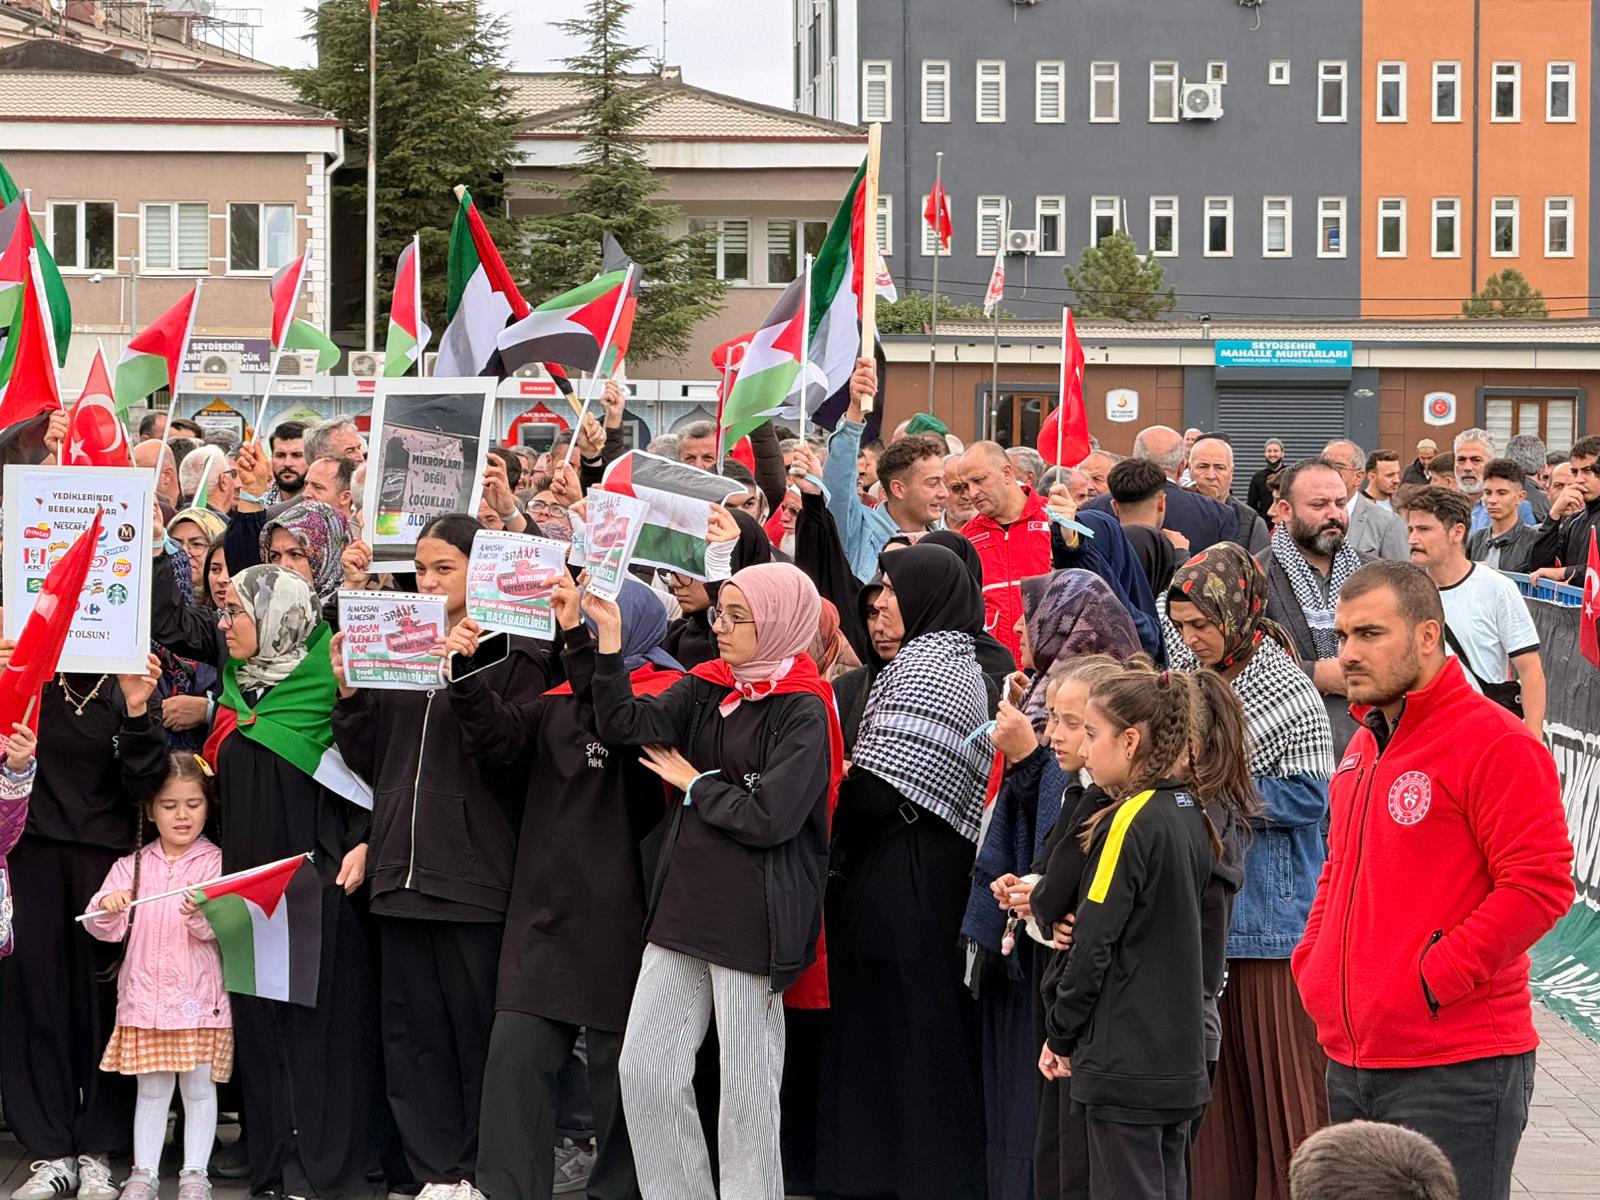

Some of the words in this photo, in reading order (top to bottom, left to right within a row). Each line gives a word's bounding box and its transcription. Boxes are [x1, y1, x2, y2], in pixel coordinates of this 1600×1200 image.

[191, 341, 245, 352] SEYDİŞEHİR
[1220, 349, 1272, 358] MAHALLE
[1275, 350, 1347, 358] MUHTARLARI
[412, 454, 461, 470] MİKROPLARI
[423, 472, 447, 486] DEĞİL
[52, 491, 114, 502] YEDİKLERİNDE
[408, 494, 455, 509] ÇOCUKLARI
[48, 505, 75, 514] BEBEK
[77, 506, 96, 515] KAN
[105, 508, 117, 516] AR
[53, 521, 88, 531] NESCAFÉ
[346, 605, 380, 613] ALMAZSAN
[486, 611, 549, 630] BAŞARABİLİRİZ!
[346, 623, 380, 633] ALIRSAN
[351, 644, 368, 654] VAR
[383, 670, 438, 684] BAŞARABİLİRİZ!
